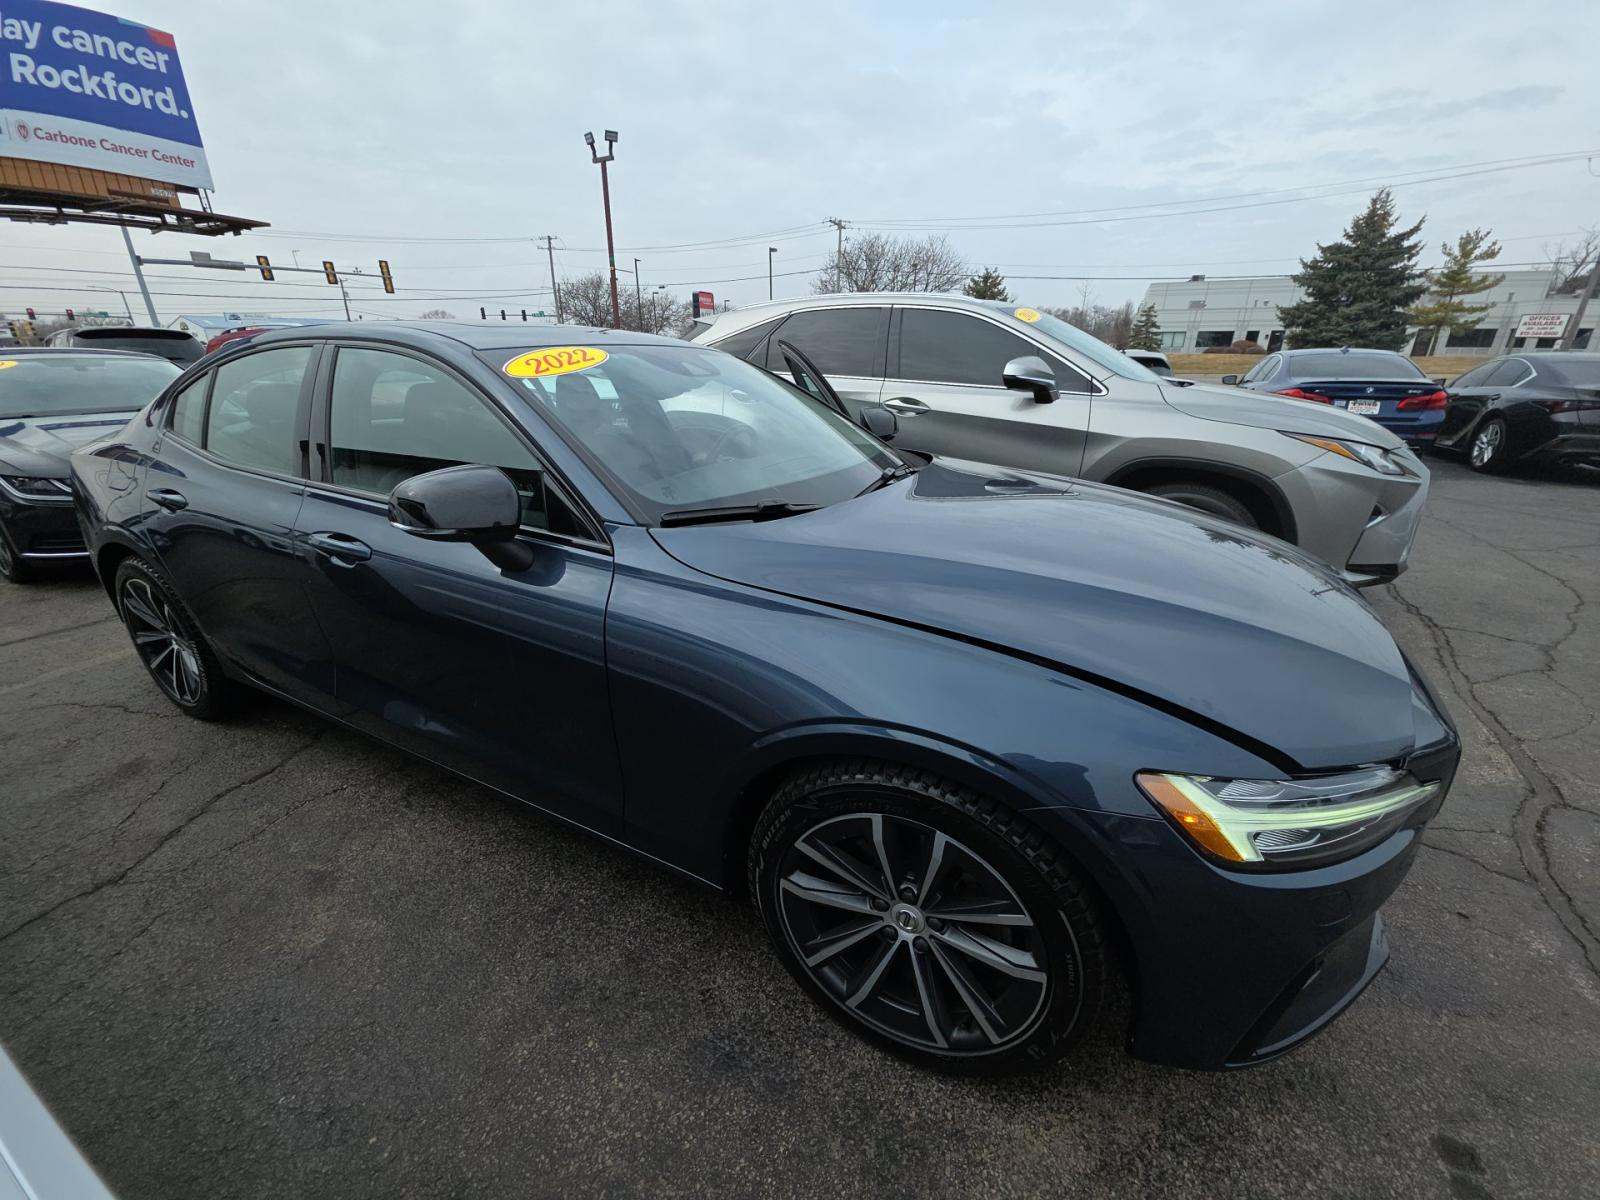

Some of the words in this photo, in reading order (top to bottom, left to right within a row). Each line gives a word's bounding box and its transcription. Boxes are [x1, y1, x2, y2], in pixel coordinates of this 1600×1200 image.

[0, 12, 42, 49] ay
[52, 25, 170, 73] cancer
[10, 52, 189, 119] Rockford.
[33, 127, 97, 149] Carbone
[100, 138, 149, 159] Cancer
[151, 149, 196, 169] Center
[525, 349, 595, 374] 2022
